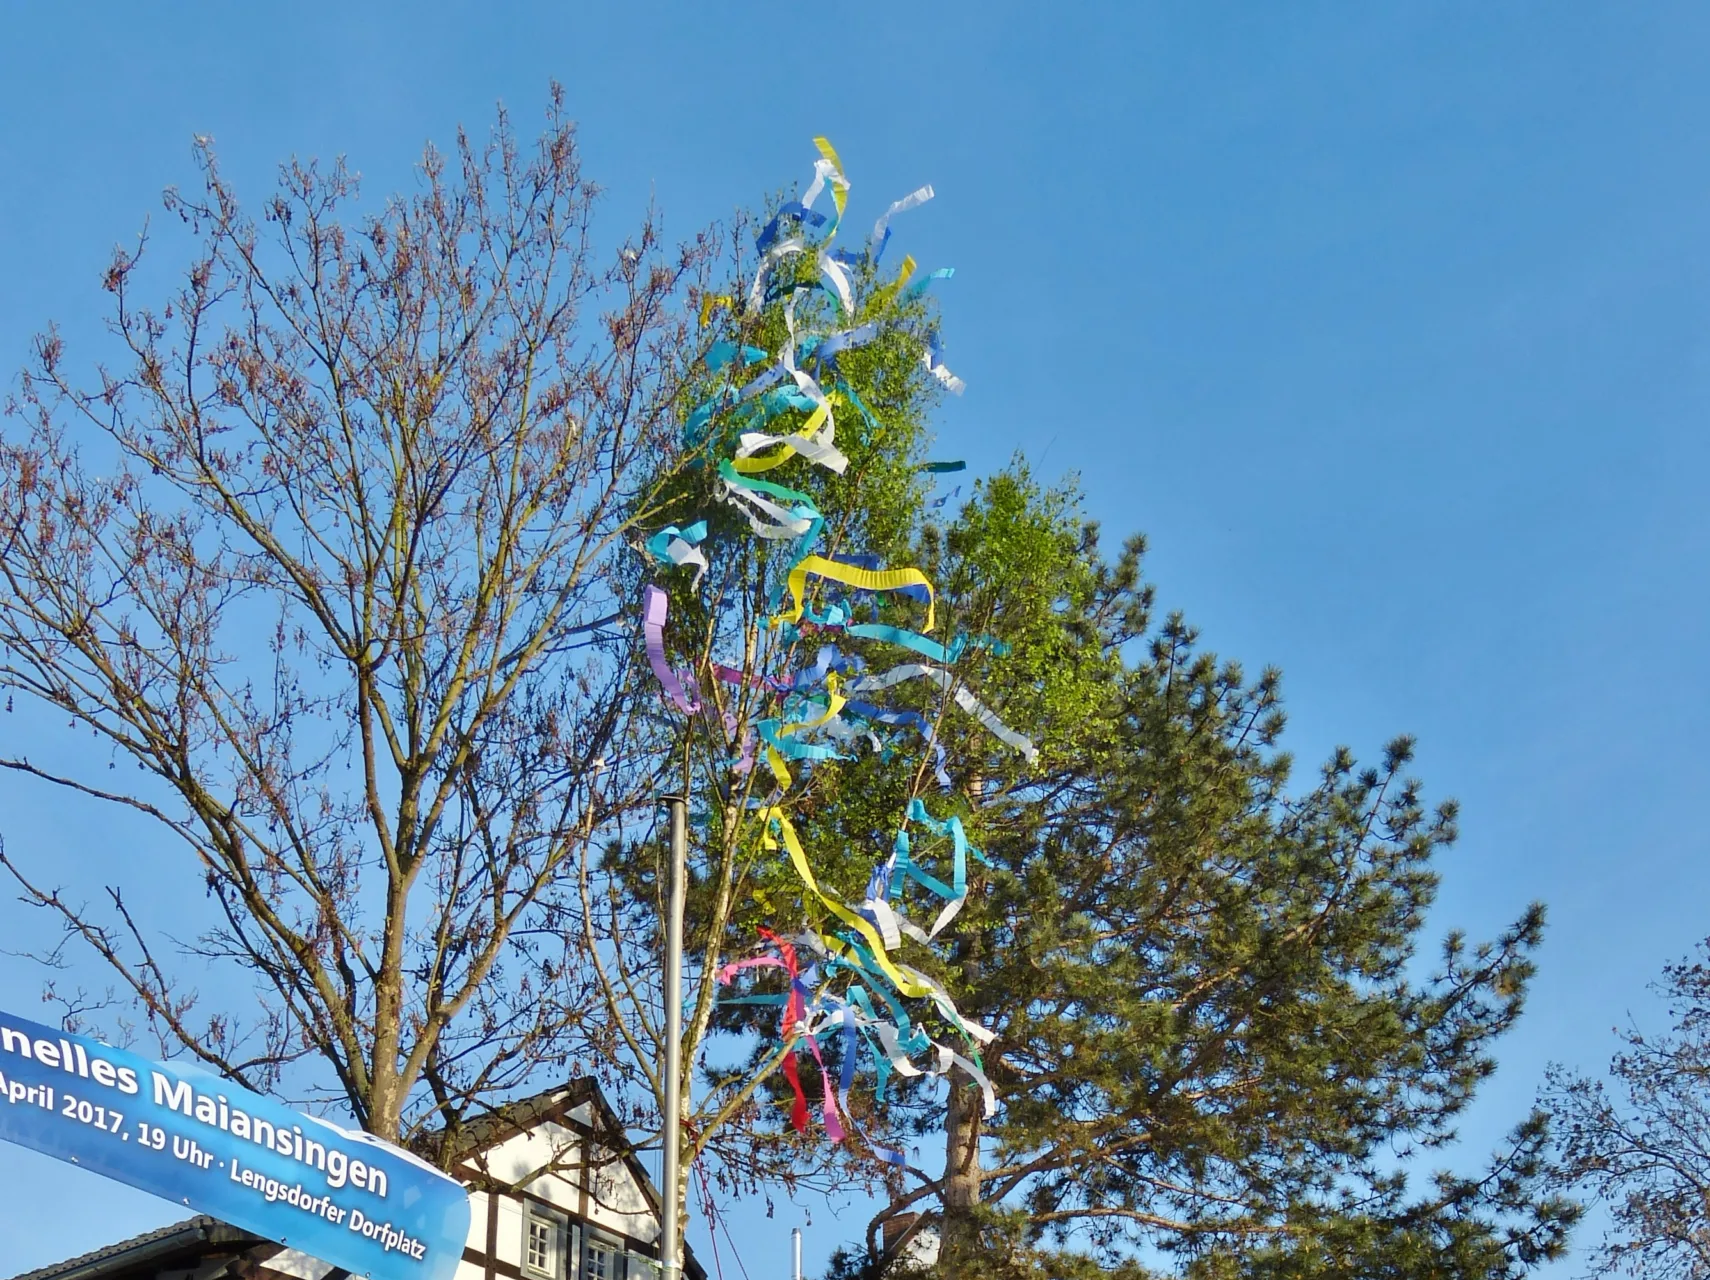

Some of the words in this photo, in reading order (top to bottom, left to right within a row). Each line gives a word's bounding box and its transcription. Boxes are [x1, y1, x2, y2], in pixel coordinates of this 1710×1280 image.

[1, 1026, 139, 1095] nelles
[151, 1071, 388, 1198] Maiansingen
[62, 1094, 129, 1141] 2017,
[137, 1123, 166, 1151] 19
[172, 1135, 214, 1169] Uhr
[230, 1158, 347, 1225] Lengsdorfer
[348, 1208, 427, 1261] Dorfplatz
